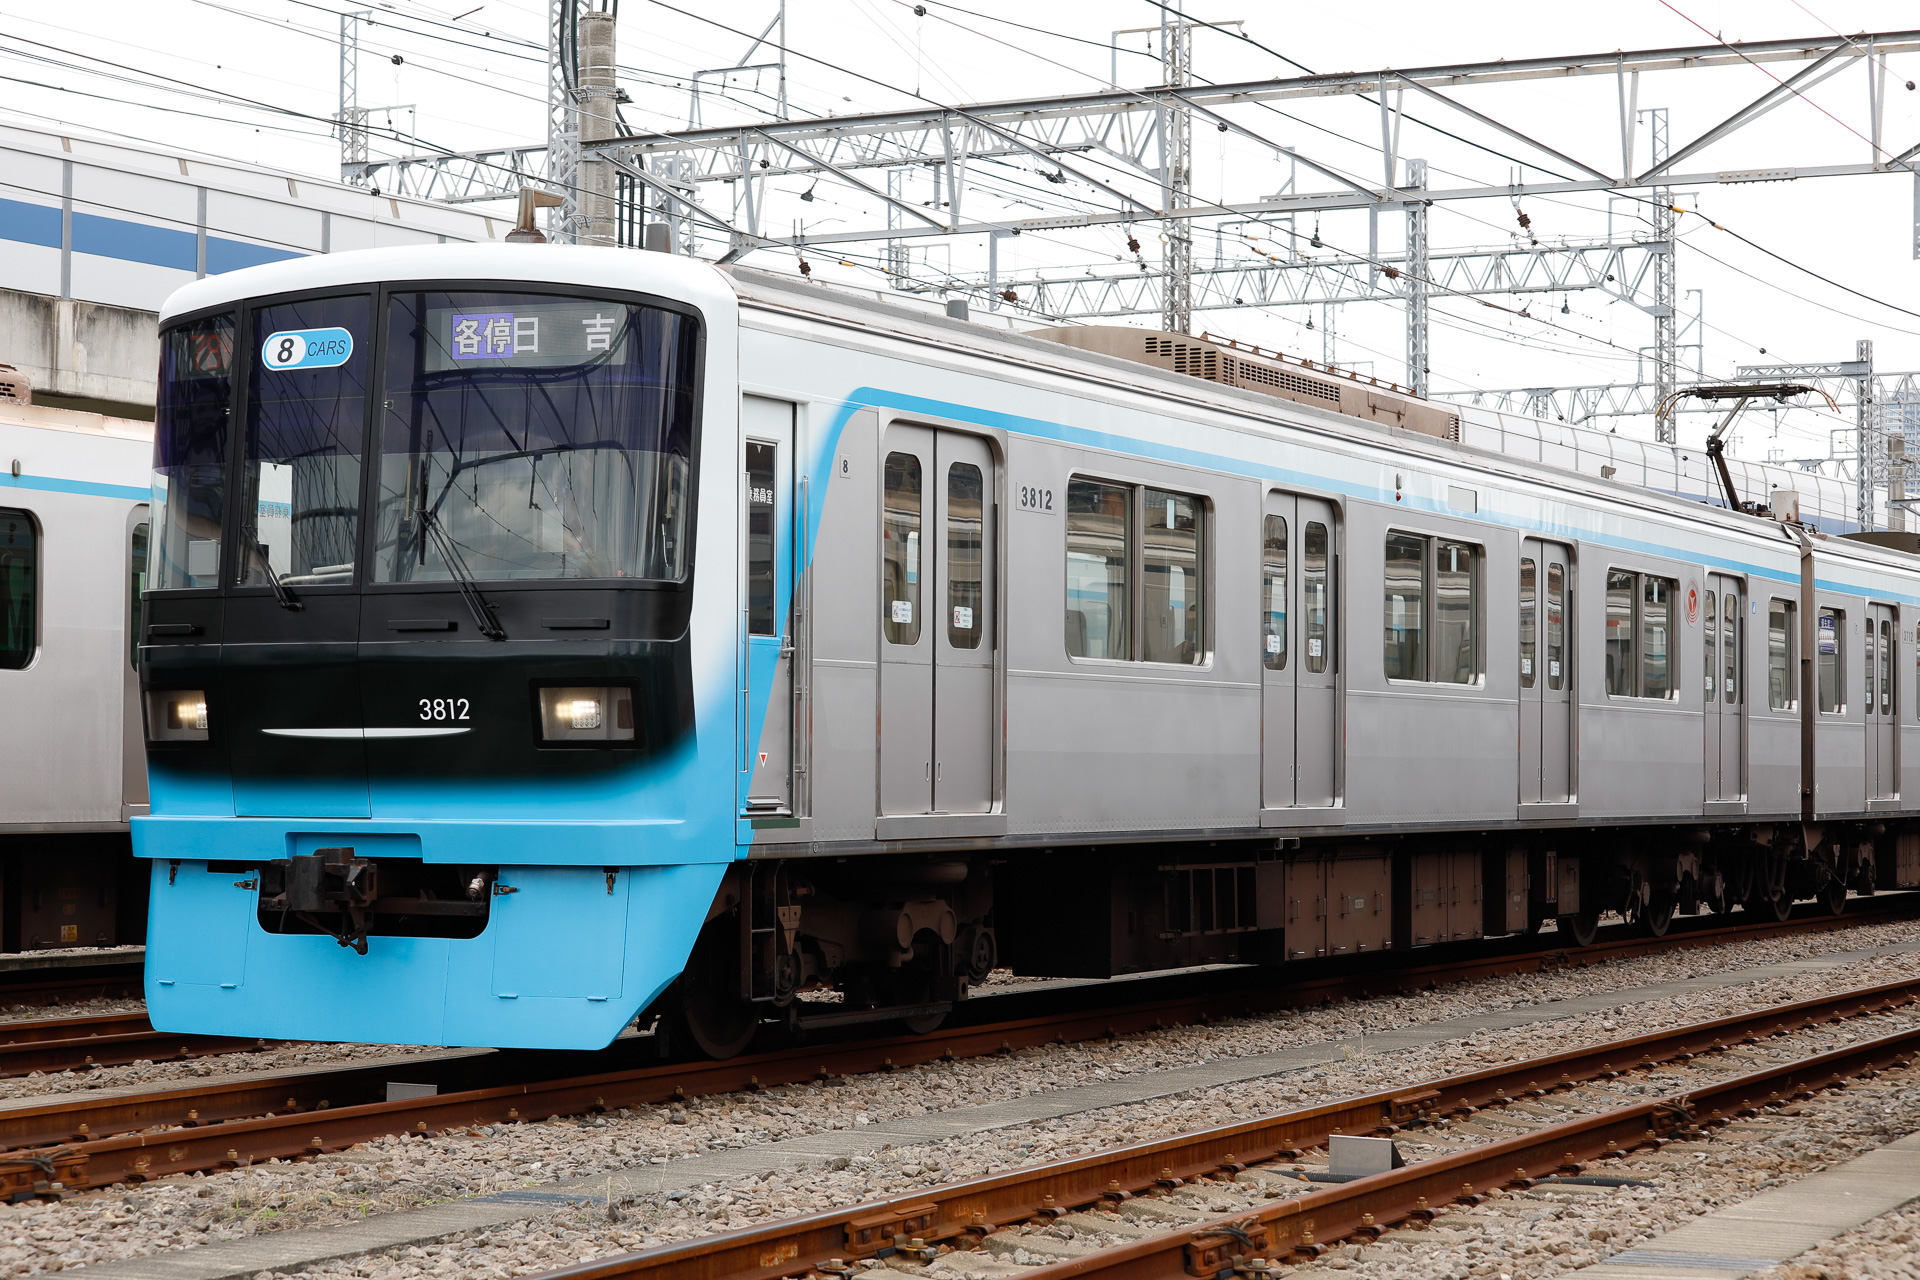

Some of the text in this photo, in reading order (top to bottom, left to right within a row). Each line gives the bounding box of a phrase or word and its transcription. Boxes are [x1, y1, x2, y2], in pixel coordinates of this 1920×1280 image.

[454, 317, 511, 355] 各停
[277, 338, 346, 363] 8 CARS
[843, 459, 848, 473] 8
[1021, 486, 1052, 510] 3812
[419, 698, 470, 720] 3812
